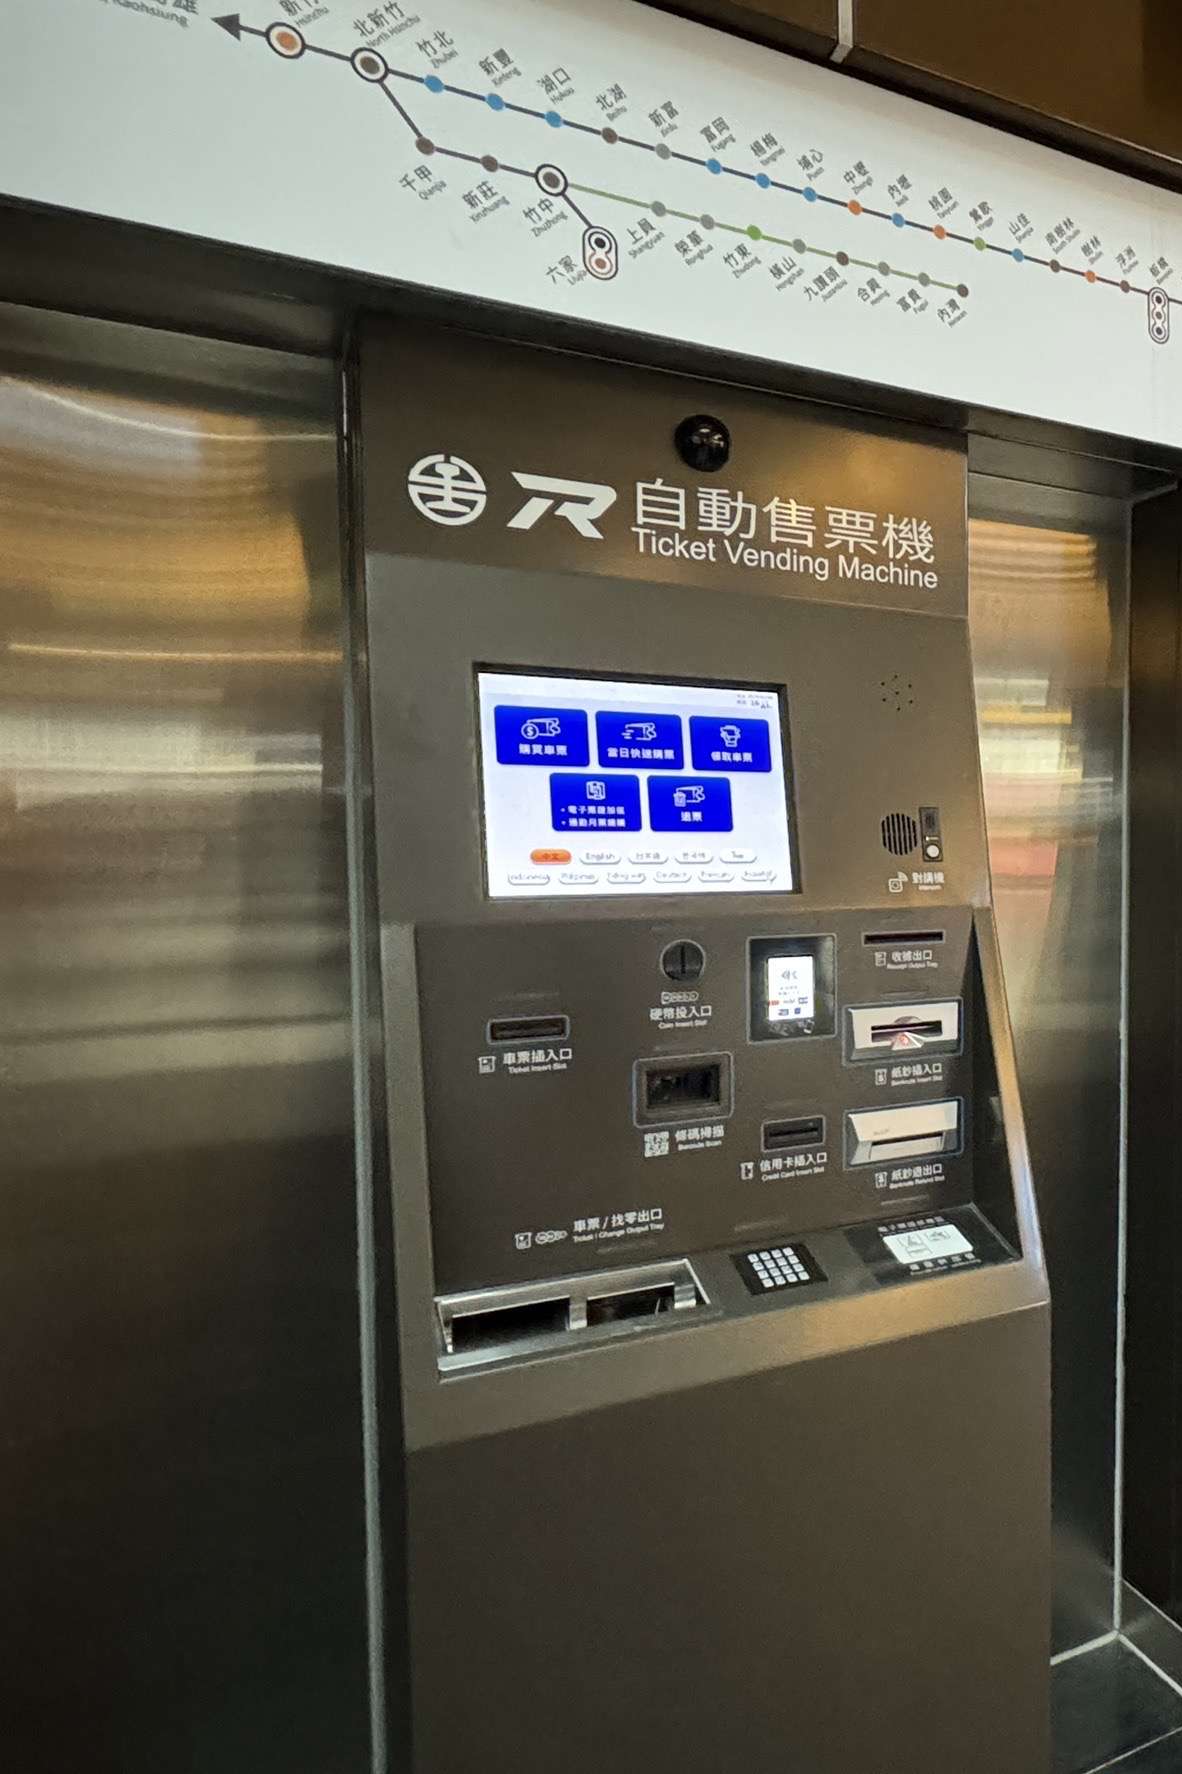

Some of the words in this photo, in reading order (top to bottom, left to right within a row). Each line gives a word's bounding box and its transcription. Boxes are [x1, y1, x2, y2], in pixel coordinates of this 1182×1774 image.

[353, 1, 405, 38] 北新竹
[416, 30, 455, 58] 竹北
[536, 67, 571, 95] 湖口
[595, 82, 628, 112] 北湖
[648, 100, 679, 129] 新富
[398, 164, 433, 192] 千甲
[523, 197, 554, 224] 竹中
[1008, 213, 1031, 236] 山佳
[545, 255, 578, 285] 六家
[722, 243, 753, 269] 竹東
[632, 477, 936, 564] 自動售票機
[630, 526, 717, 562] Ticket
[725, 540, 830, 583] Vending
[838, 554, 939, 589] Machine
[649, 1005, 712, 1021] 硬幣投入口
[503, 1048, 572, 1065] 車票插入口
[759, 1152, 828, 1172] 信用卡插入口
[611, 1208, 662, 1227] 找零出口
